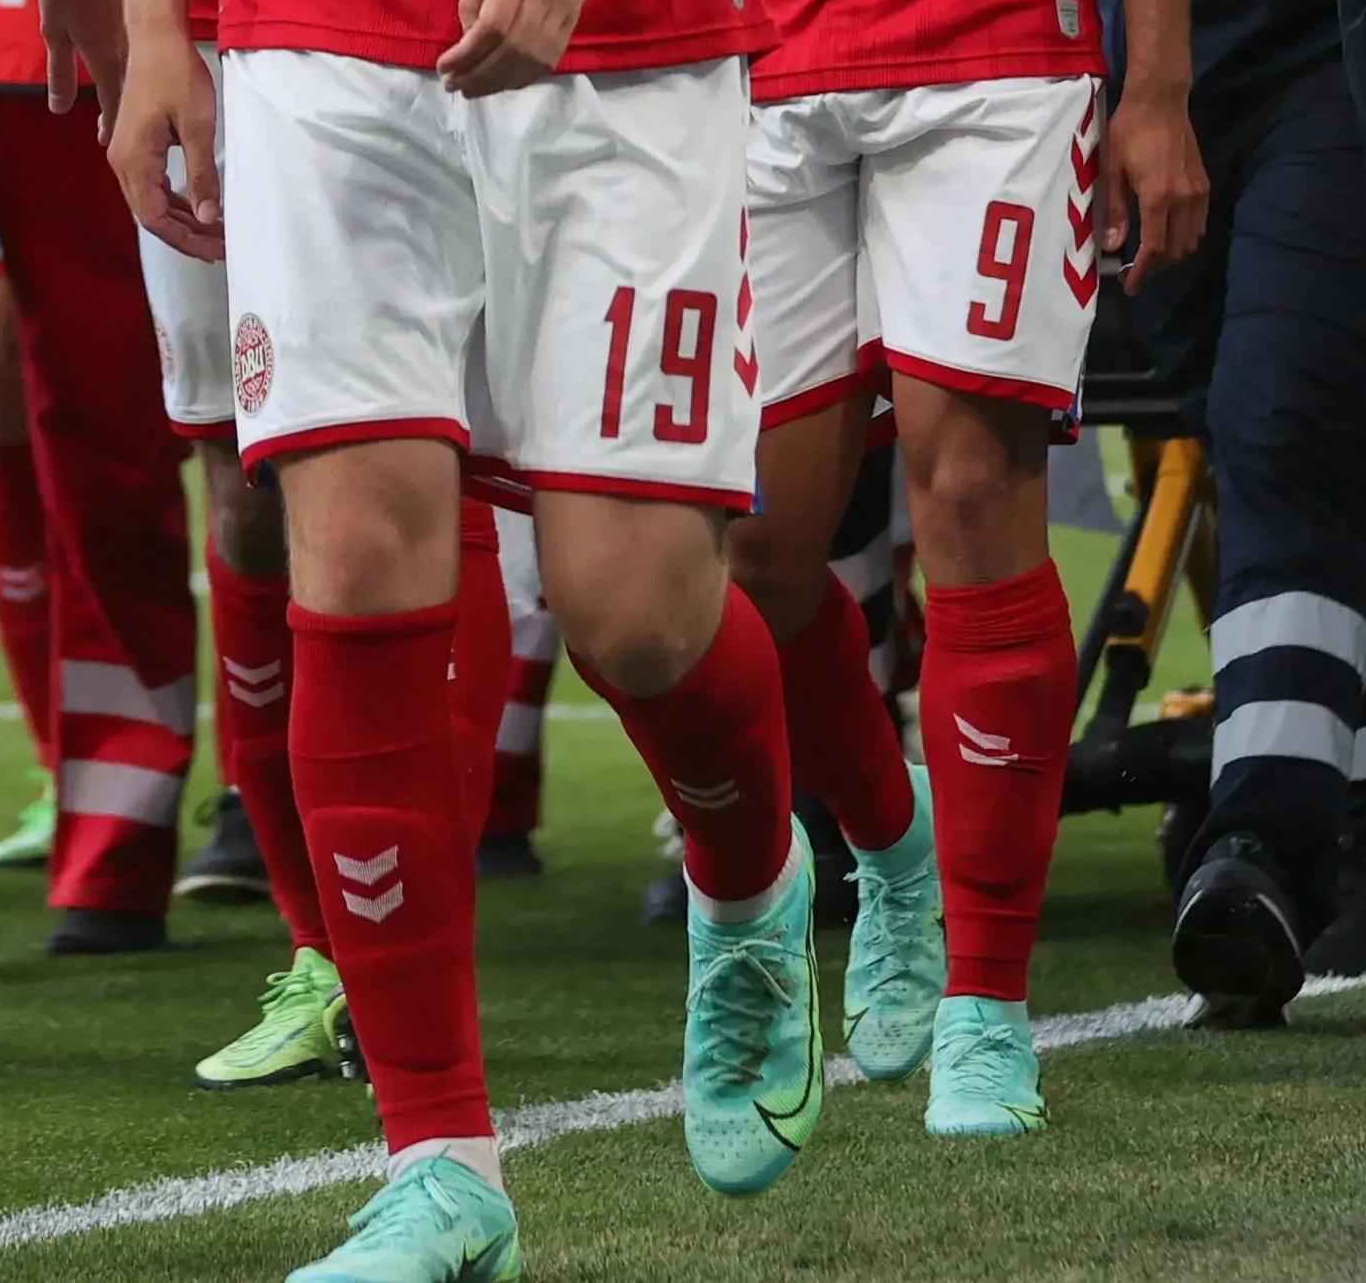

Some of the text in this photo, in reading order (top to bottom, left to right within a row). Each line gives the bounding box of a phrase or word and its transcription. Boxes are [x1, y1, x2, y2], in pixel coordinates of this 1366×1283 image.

[967, 200, 1035, 342] 9
[240, 345, 265, 381] DBU
[599, 286, 719, 445] 19
